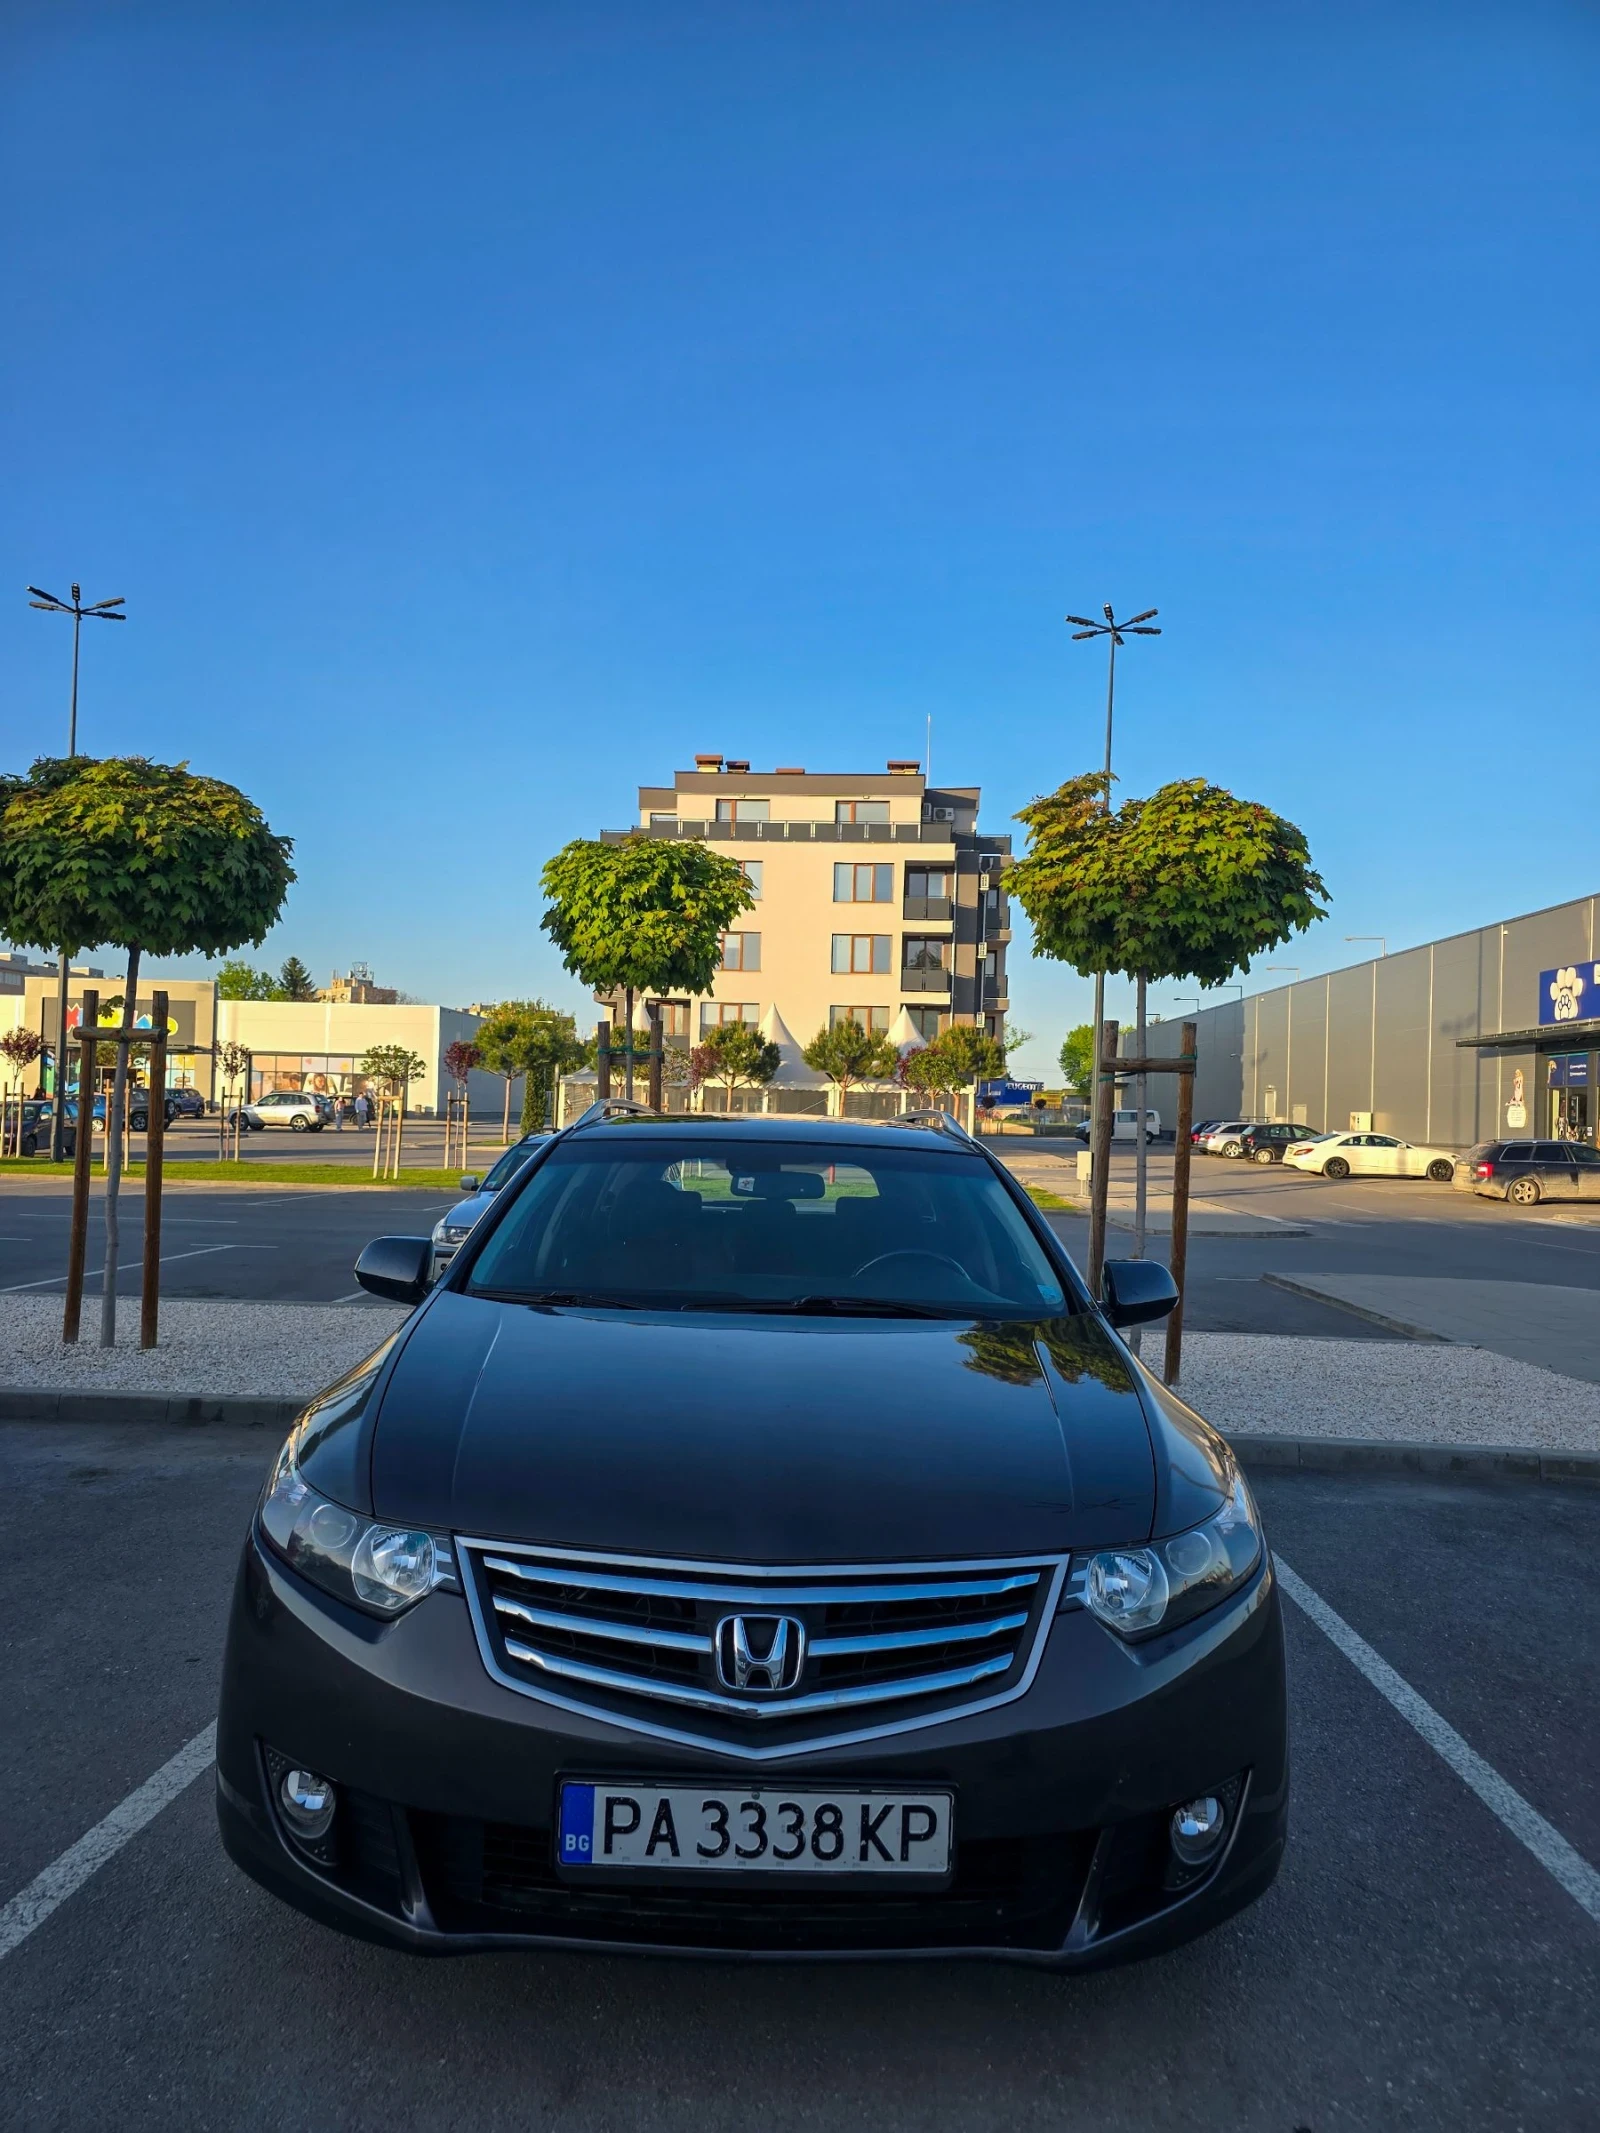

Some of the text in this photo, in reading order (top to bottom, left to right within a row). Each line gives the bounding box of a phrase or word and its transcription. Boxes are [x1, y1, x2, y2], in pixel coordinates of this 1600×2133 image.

[565, 1834, 590, 1852] BG
[604, 1796, 938, 1862] PA 3338 KP
